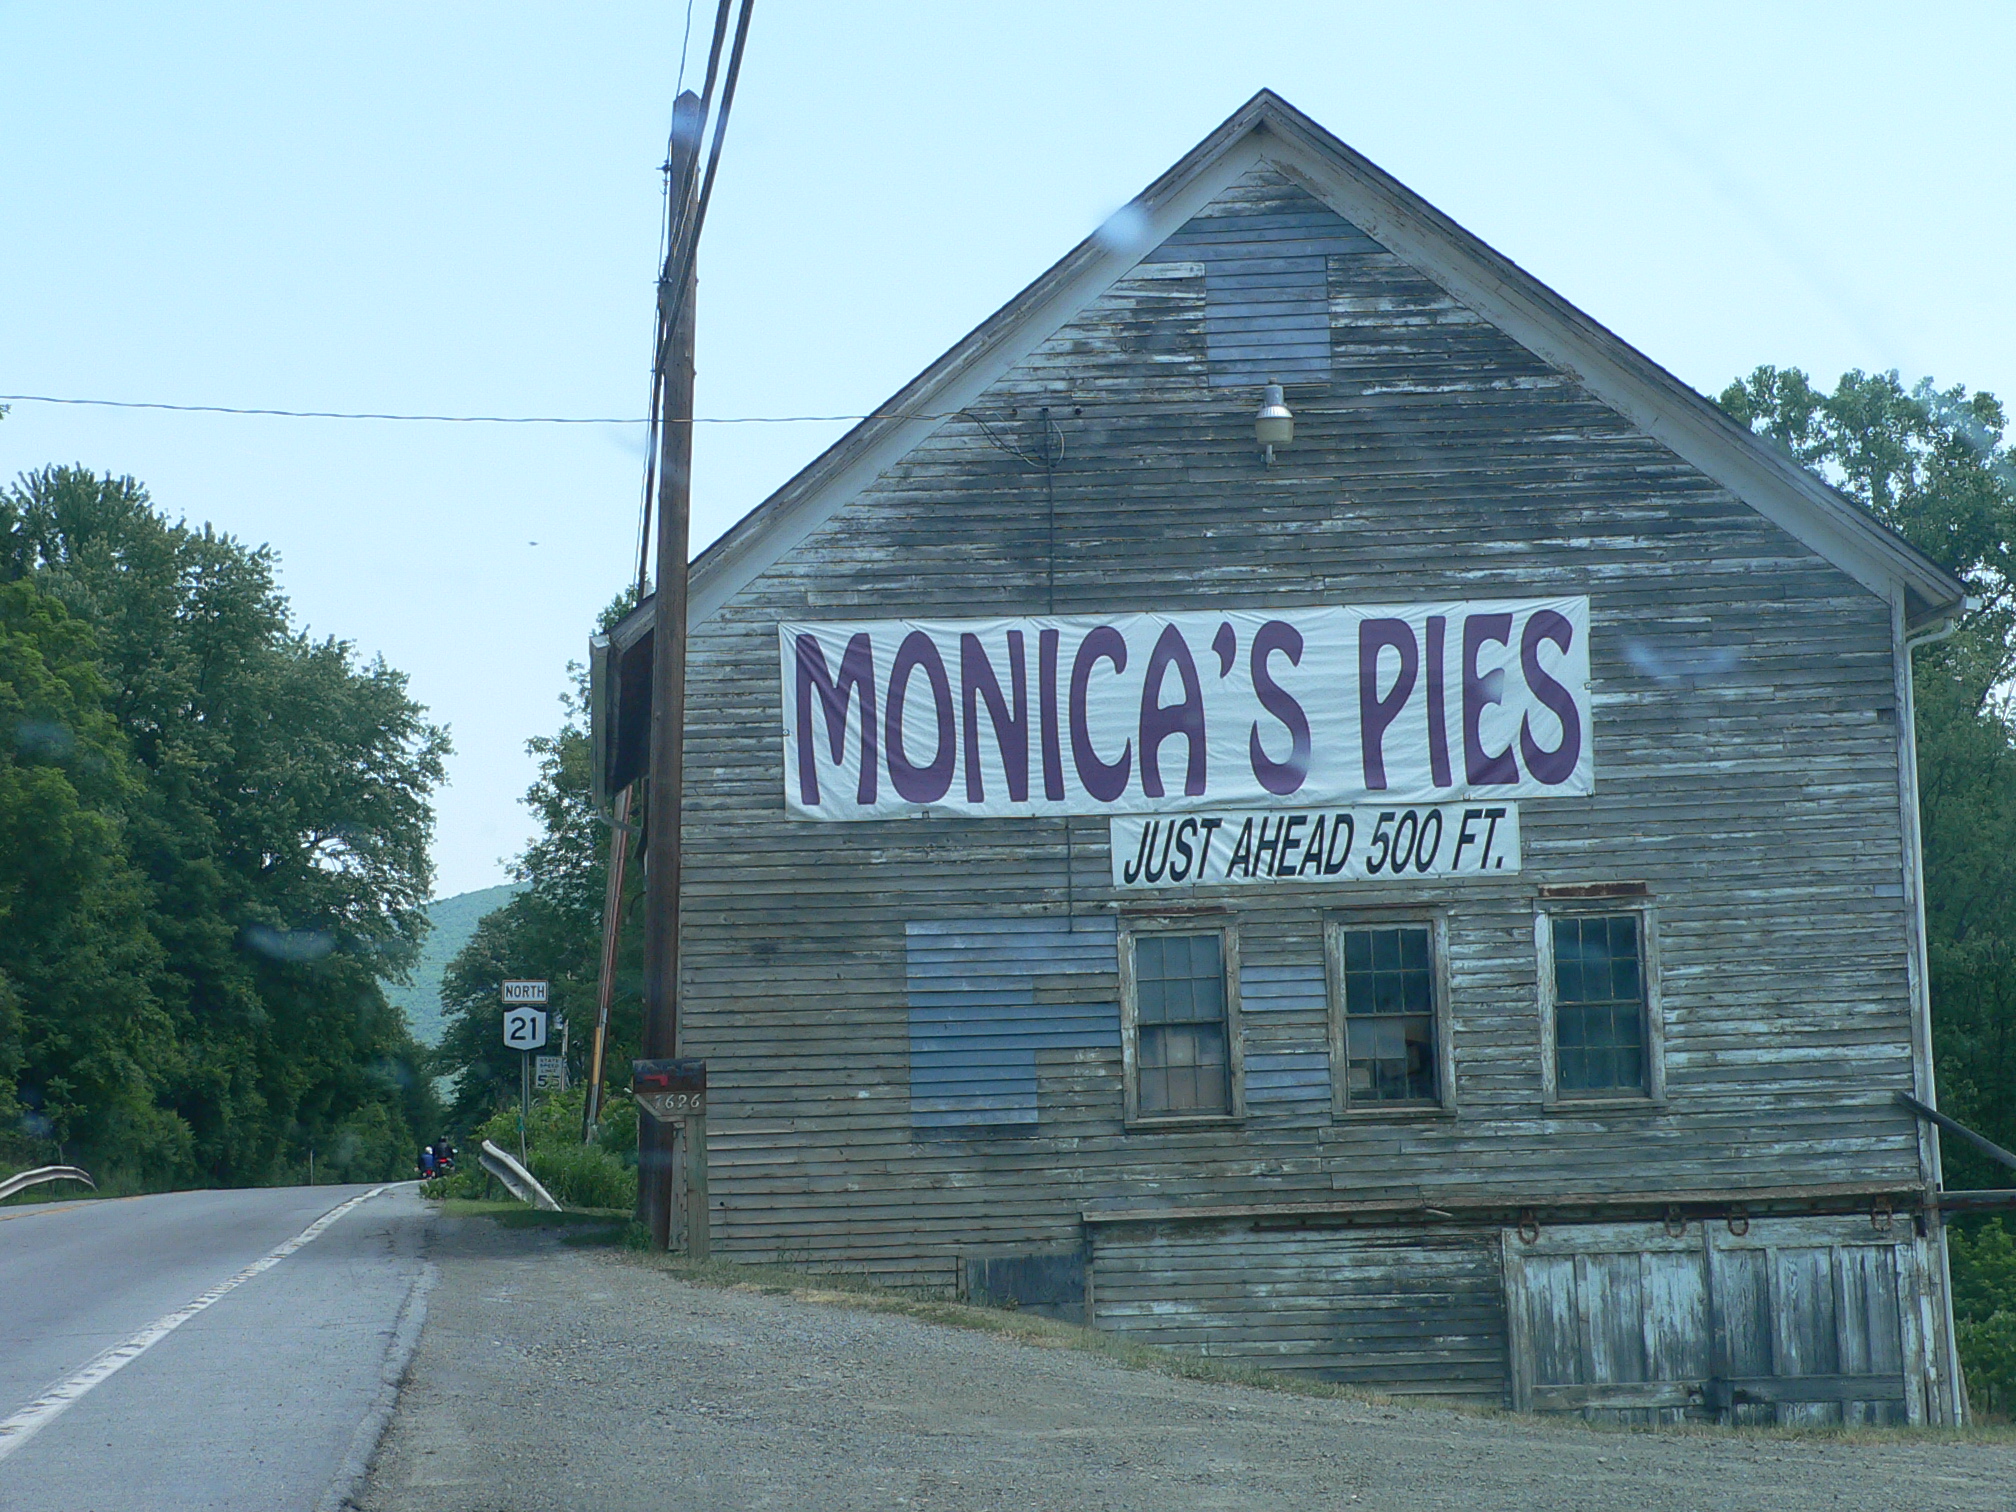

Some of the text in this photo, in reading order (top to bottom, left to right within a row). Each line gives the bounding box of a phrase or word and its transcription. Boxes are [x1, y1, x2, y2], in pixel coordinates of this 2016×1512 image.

[795, 609, 1582, 805] MONICA'S PIES
[1123, 808, 1507, 884] JUST AHEAD 500 FT.
[505, 985, 545, 998] NORTH
[510, 1016, 537, 1041] 21
[538, 1075, 560, 1087] 55
